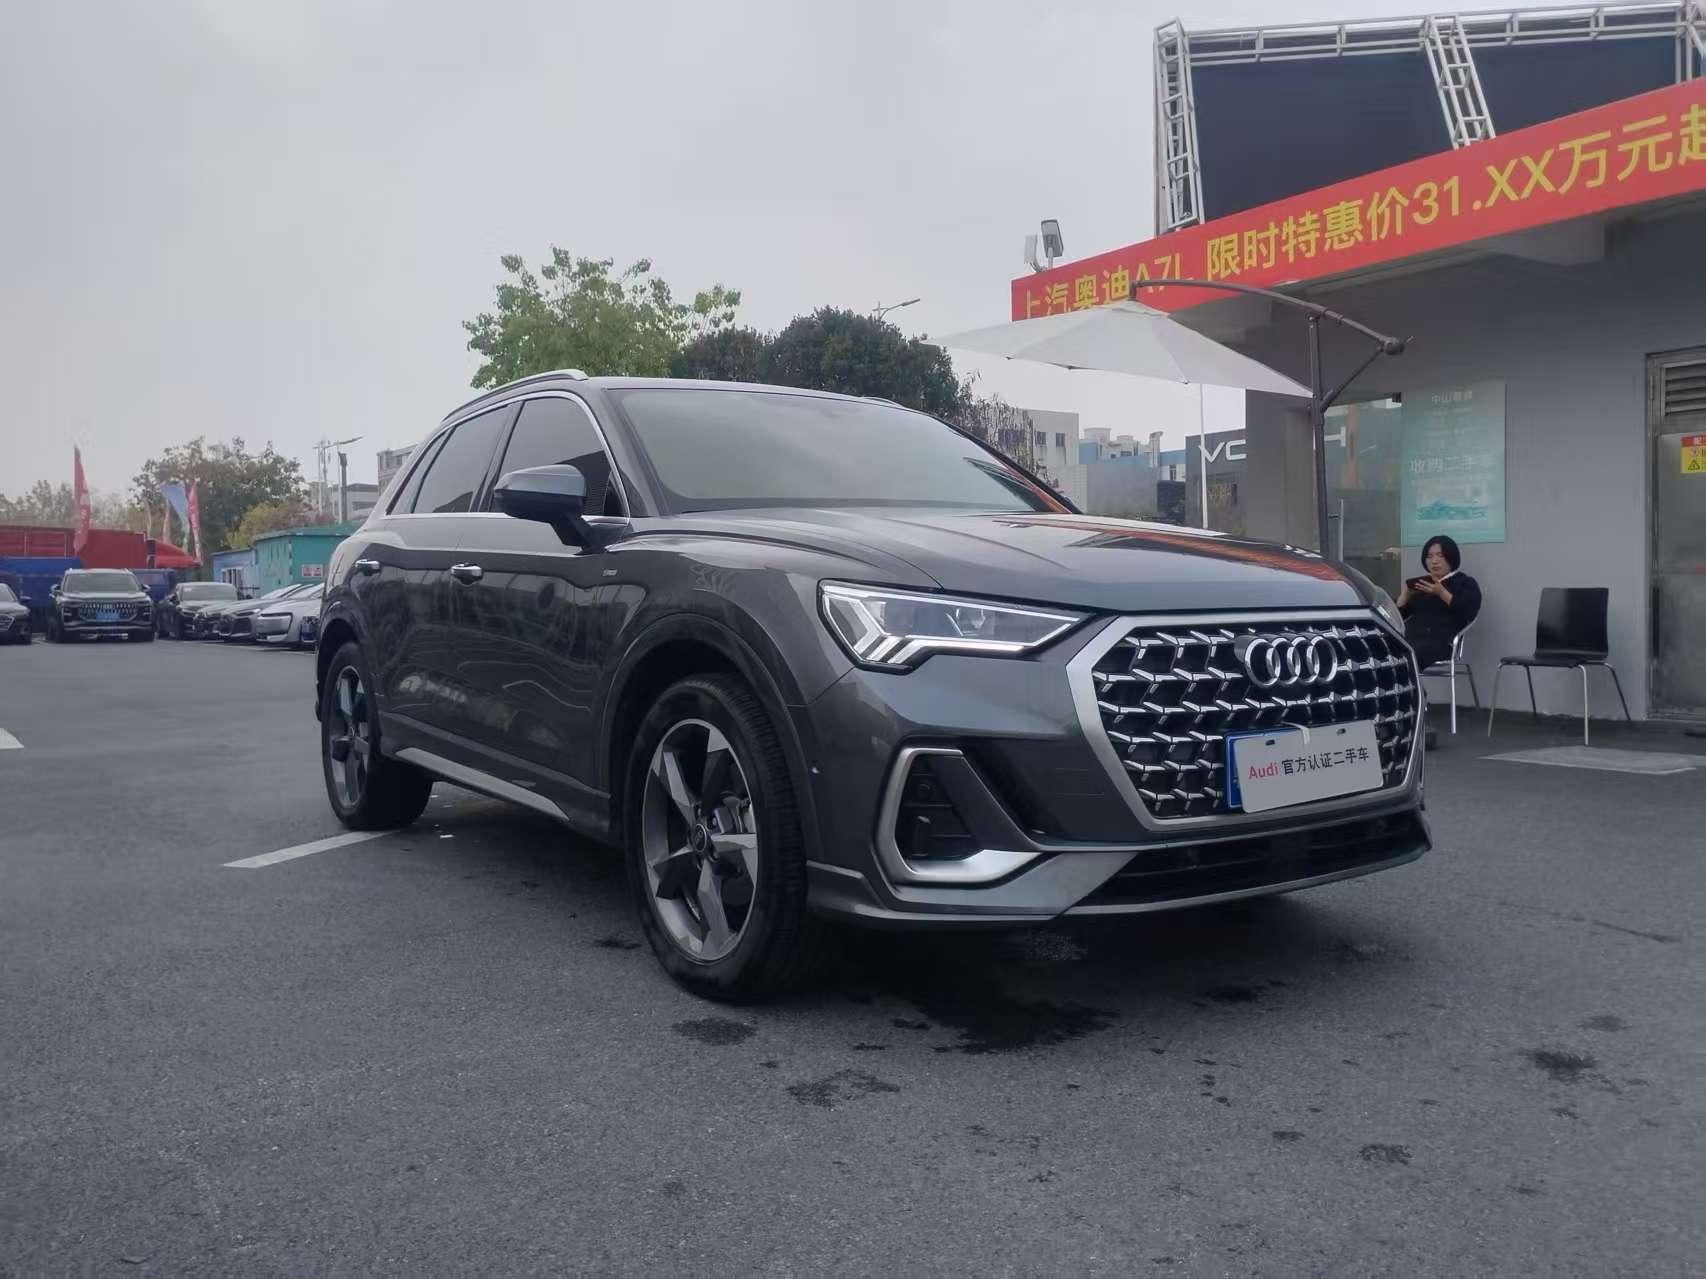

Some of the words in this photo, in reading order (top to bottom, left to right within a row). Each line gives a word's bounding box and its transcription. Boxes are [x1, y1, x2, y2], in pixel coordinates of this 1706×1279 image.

[1249, 762, 1279, 779] Audi
[1281, 747, 1370, 775] 官方认证二手车
